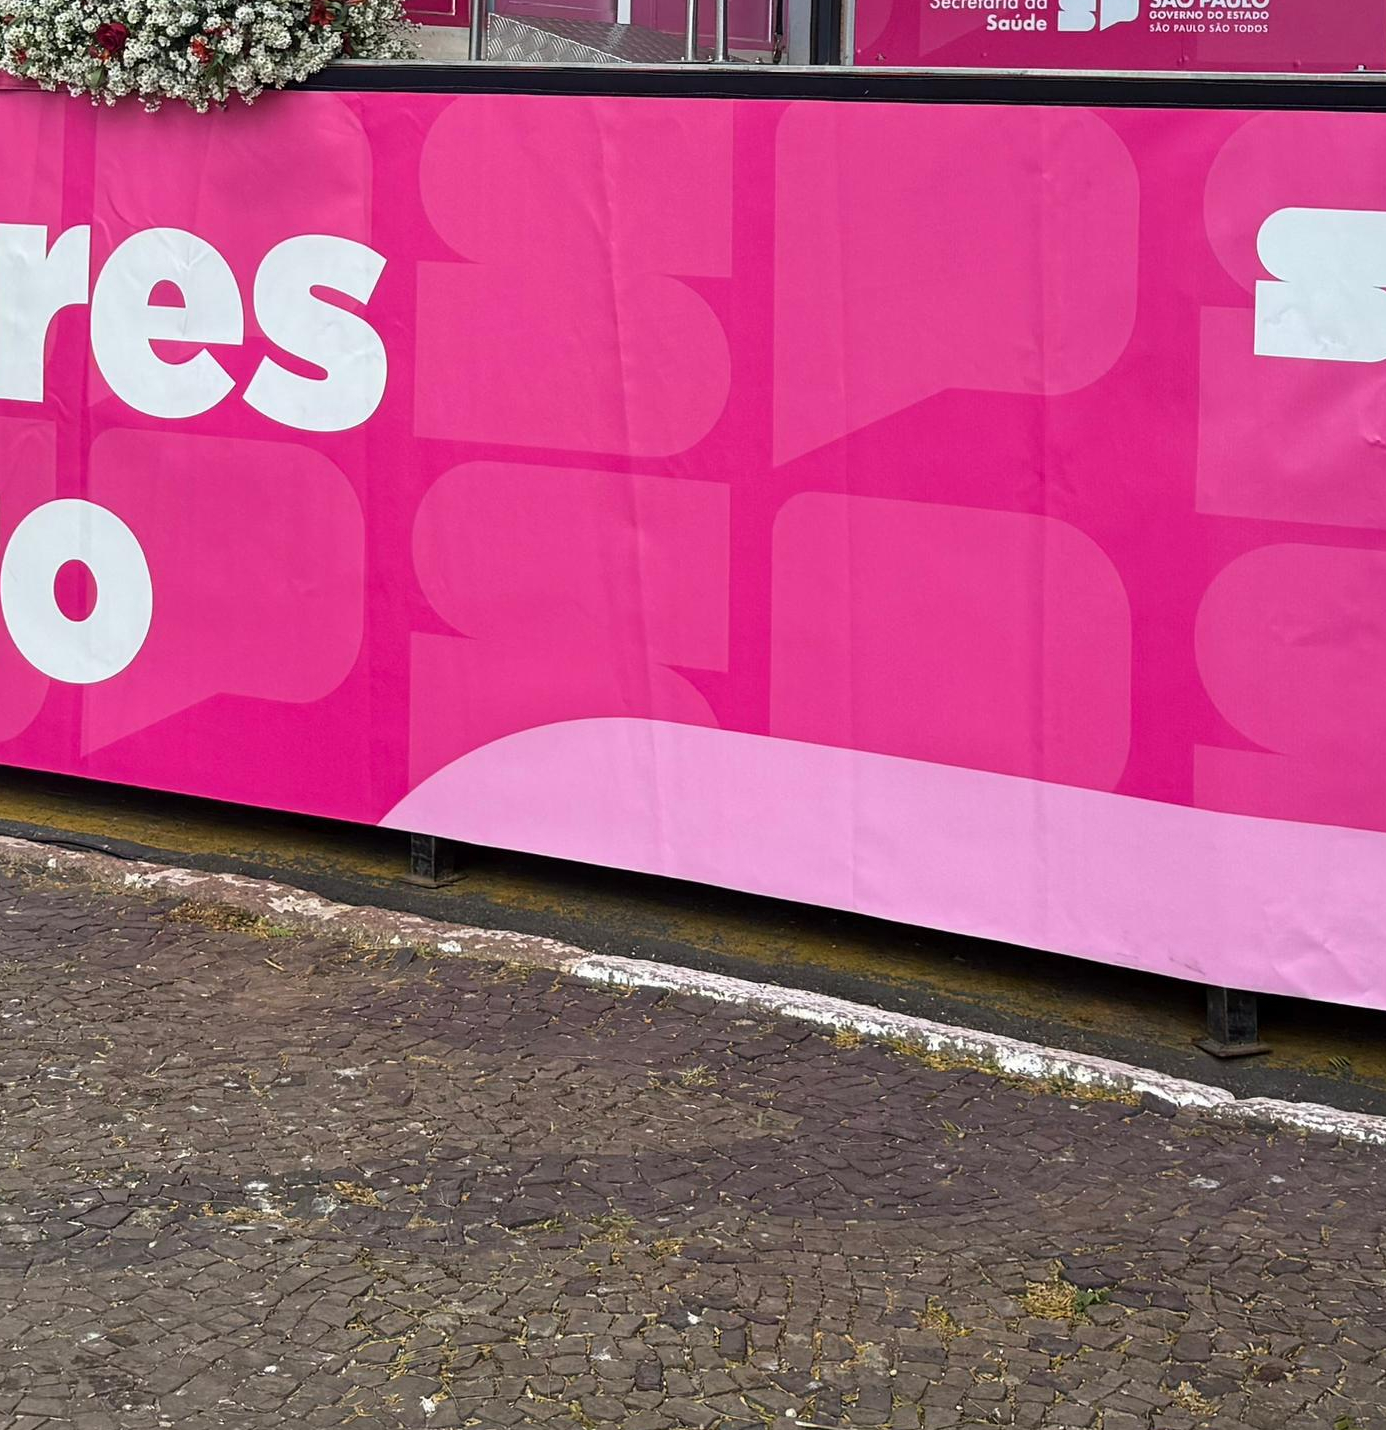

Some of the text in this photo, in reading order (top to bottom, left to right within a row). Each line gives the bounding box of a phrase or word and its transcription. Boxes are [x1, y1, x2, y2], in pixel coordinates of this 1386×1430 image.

[1149, 10, 1269, 20] GOVERNO DO ESTADO
[986, 14, 1047, 31] Saúde
[1149, 22, 1268, 33] SÃO PAULO SÃO TODOS
